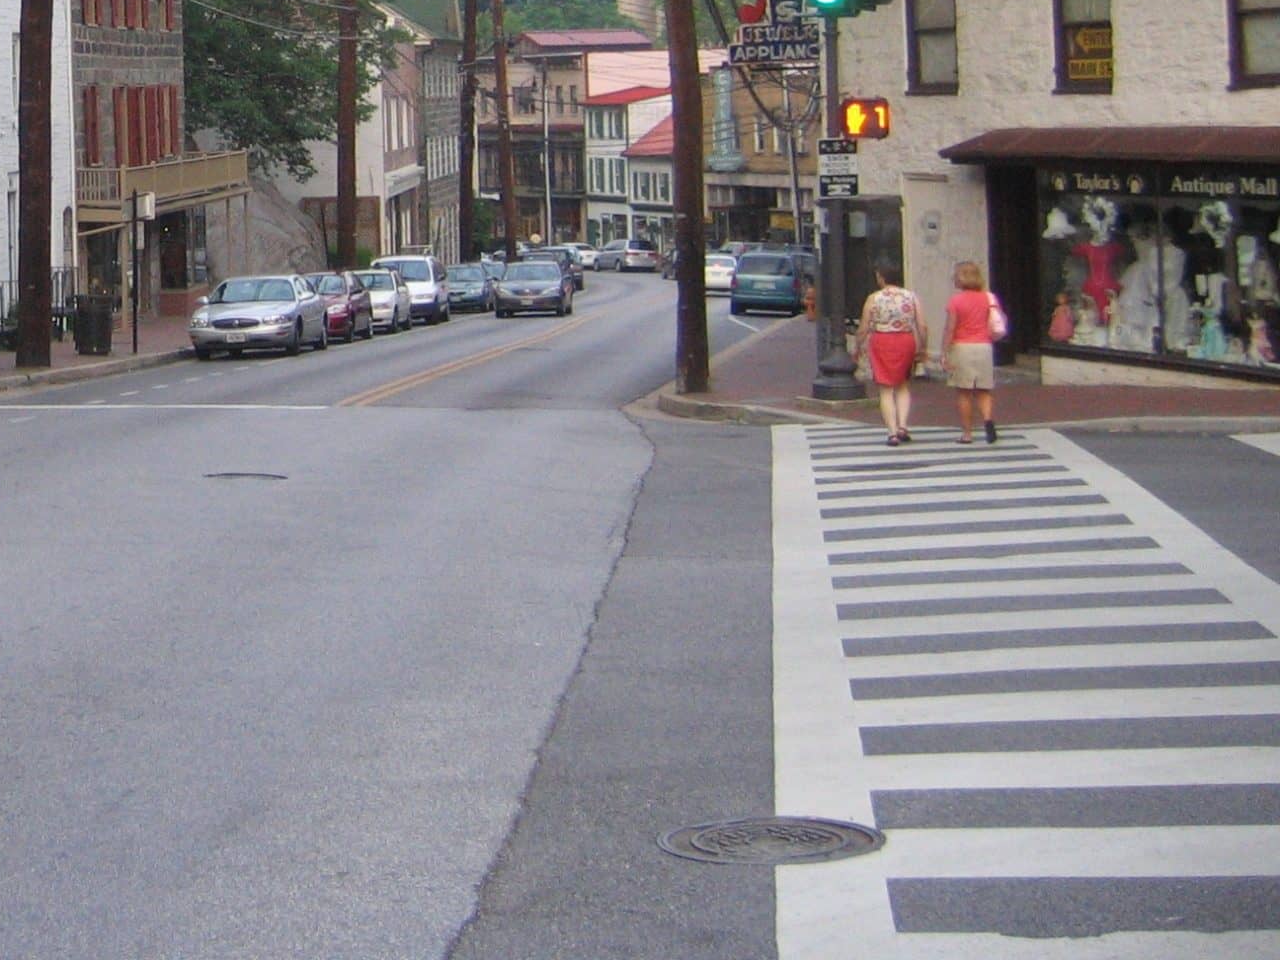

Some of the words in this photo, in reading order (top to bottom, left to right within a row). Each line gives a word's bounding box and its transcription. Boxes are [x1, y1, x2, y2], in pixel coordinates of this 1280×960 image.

[1074, 172, 1120, 191] Taylor's
[1171, 175, 1234, 197] Antique
[1239, 177, 1278, 196] Mall
